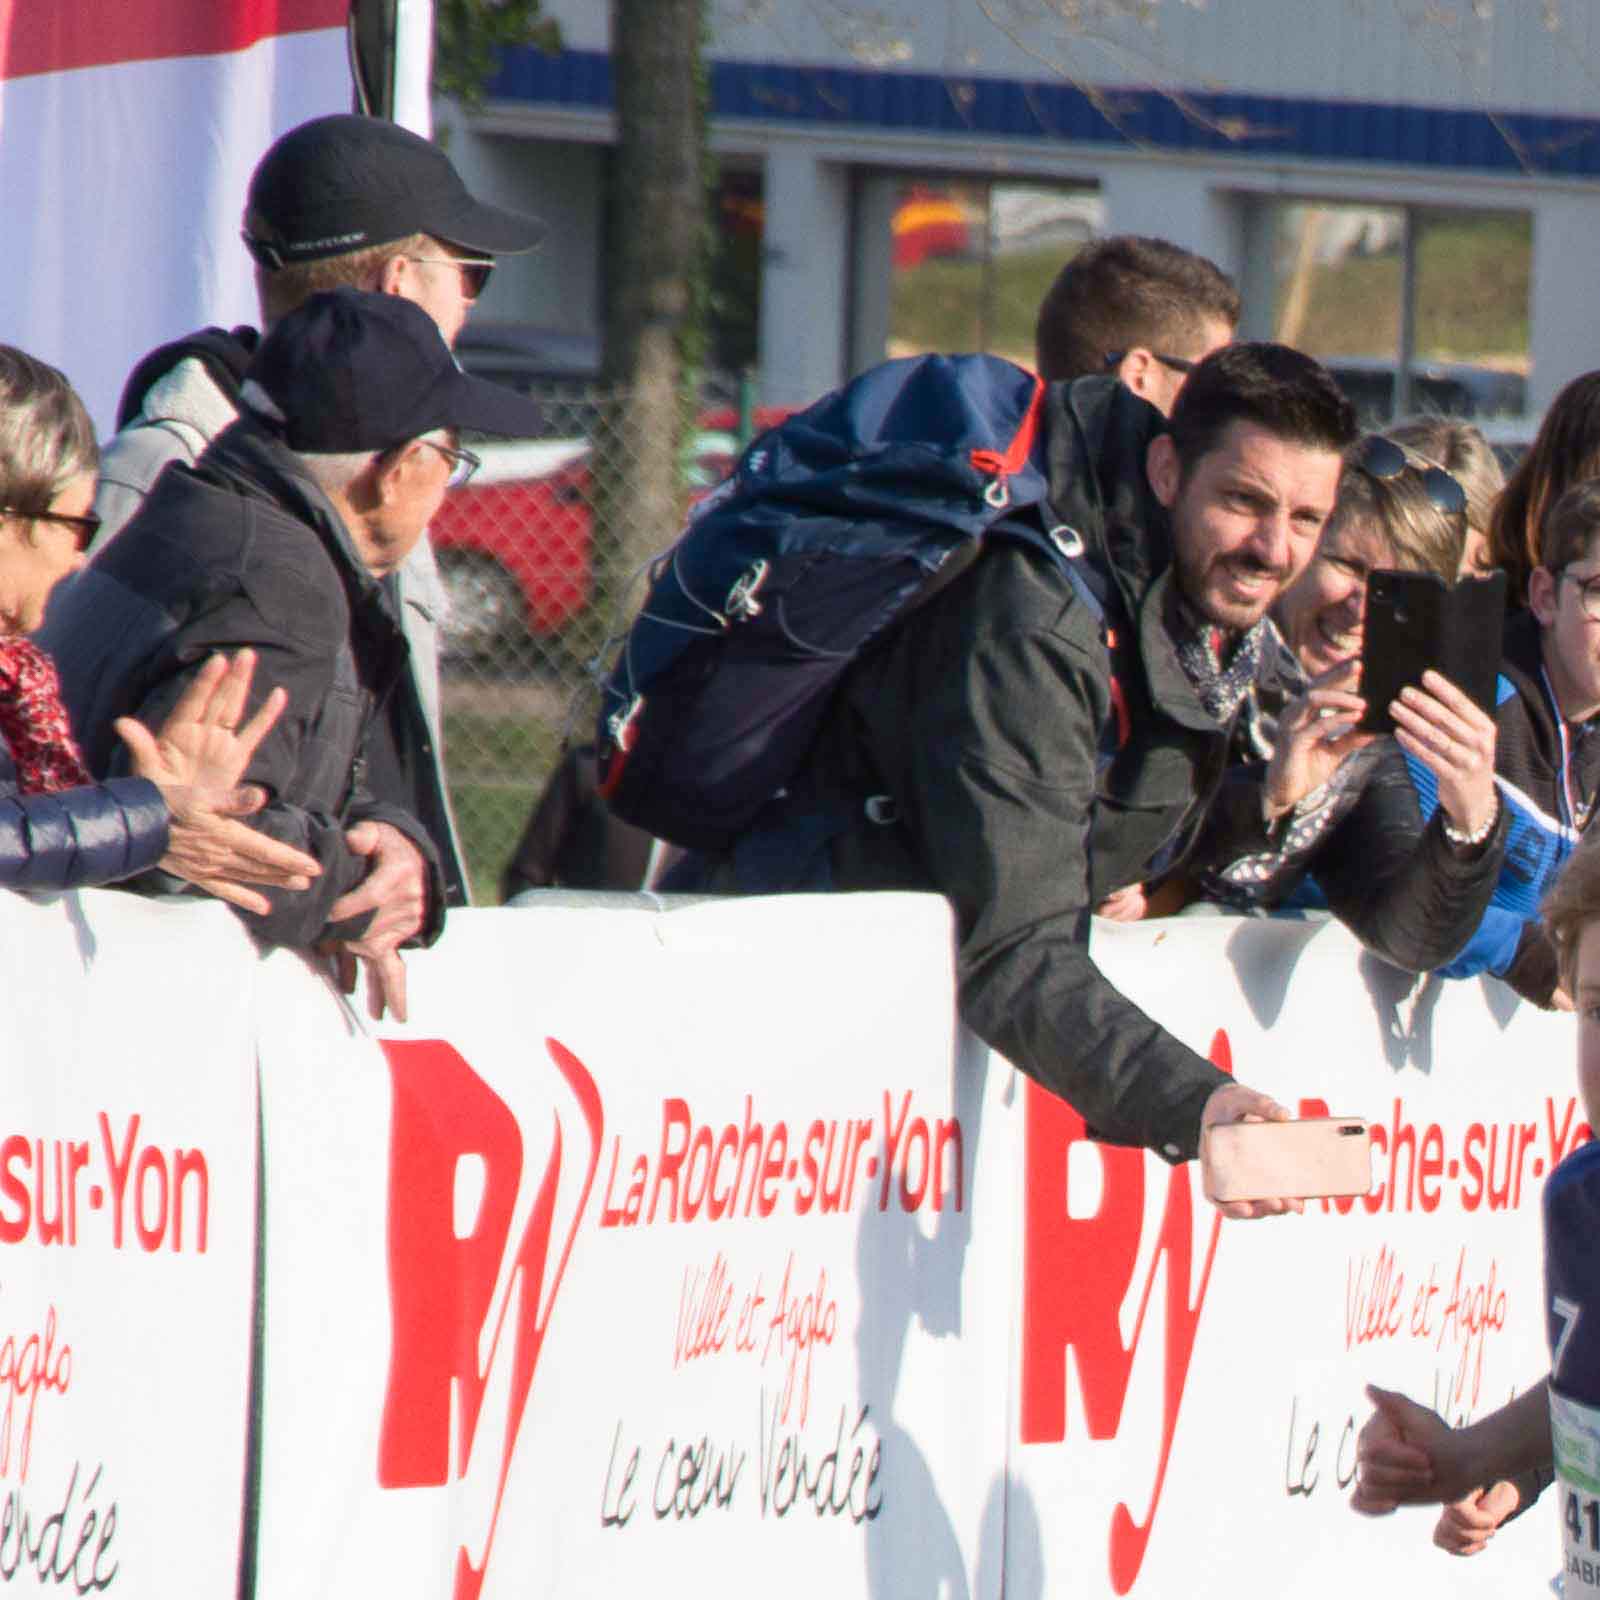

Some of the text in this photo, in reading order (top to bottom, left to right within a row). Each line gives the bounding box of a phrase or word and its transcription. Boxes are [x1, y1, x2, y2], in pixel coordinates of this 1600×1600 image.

[599, 1134, 650, 1227] La
[736, 1271, 764, 1353] et
[761, 1250, 838, 1428] Agglo
[1410, 1262, 1439, 1338] et
[1436, 1246, 1507, 1406] Agglo
[1552, 1296, 1580, 1380] 7
[601, 1419, 641, 1529] Le
[760, 1384, 885, 1526] Vendée
[1286, 1395, 1320, 1497] Le
[0, 1460, 119, 1596] endée
